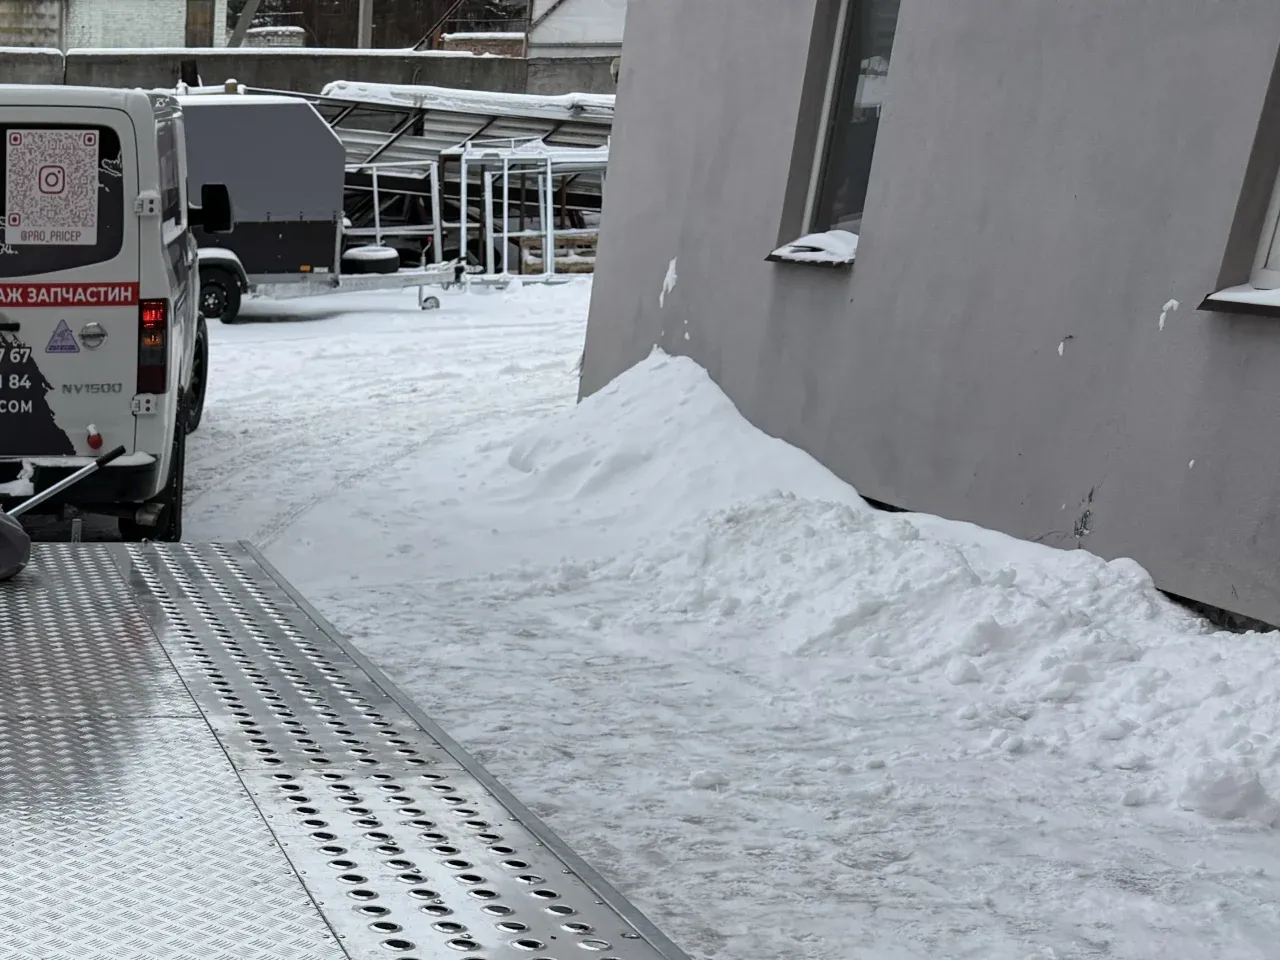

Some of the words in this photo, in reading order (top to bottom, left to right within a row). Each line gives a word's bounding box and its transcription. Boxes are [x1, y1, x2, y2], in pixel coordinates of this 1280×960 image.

[27, 286, 132, 303] ЗАПЧАСТИН
[9, 348, 31, 363] 67
[8, 374, 32, 389] 84
[61, 383, 123, 394] NV1500
